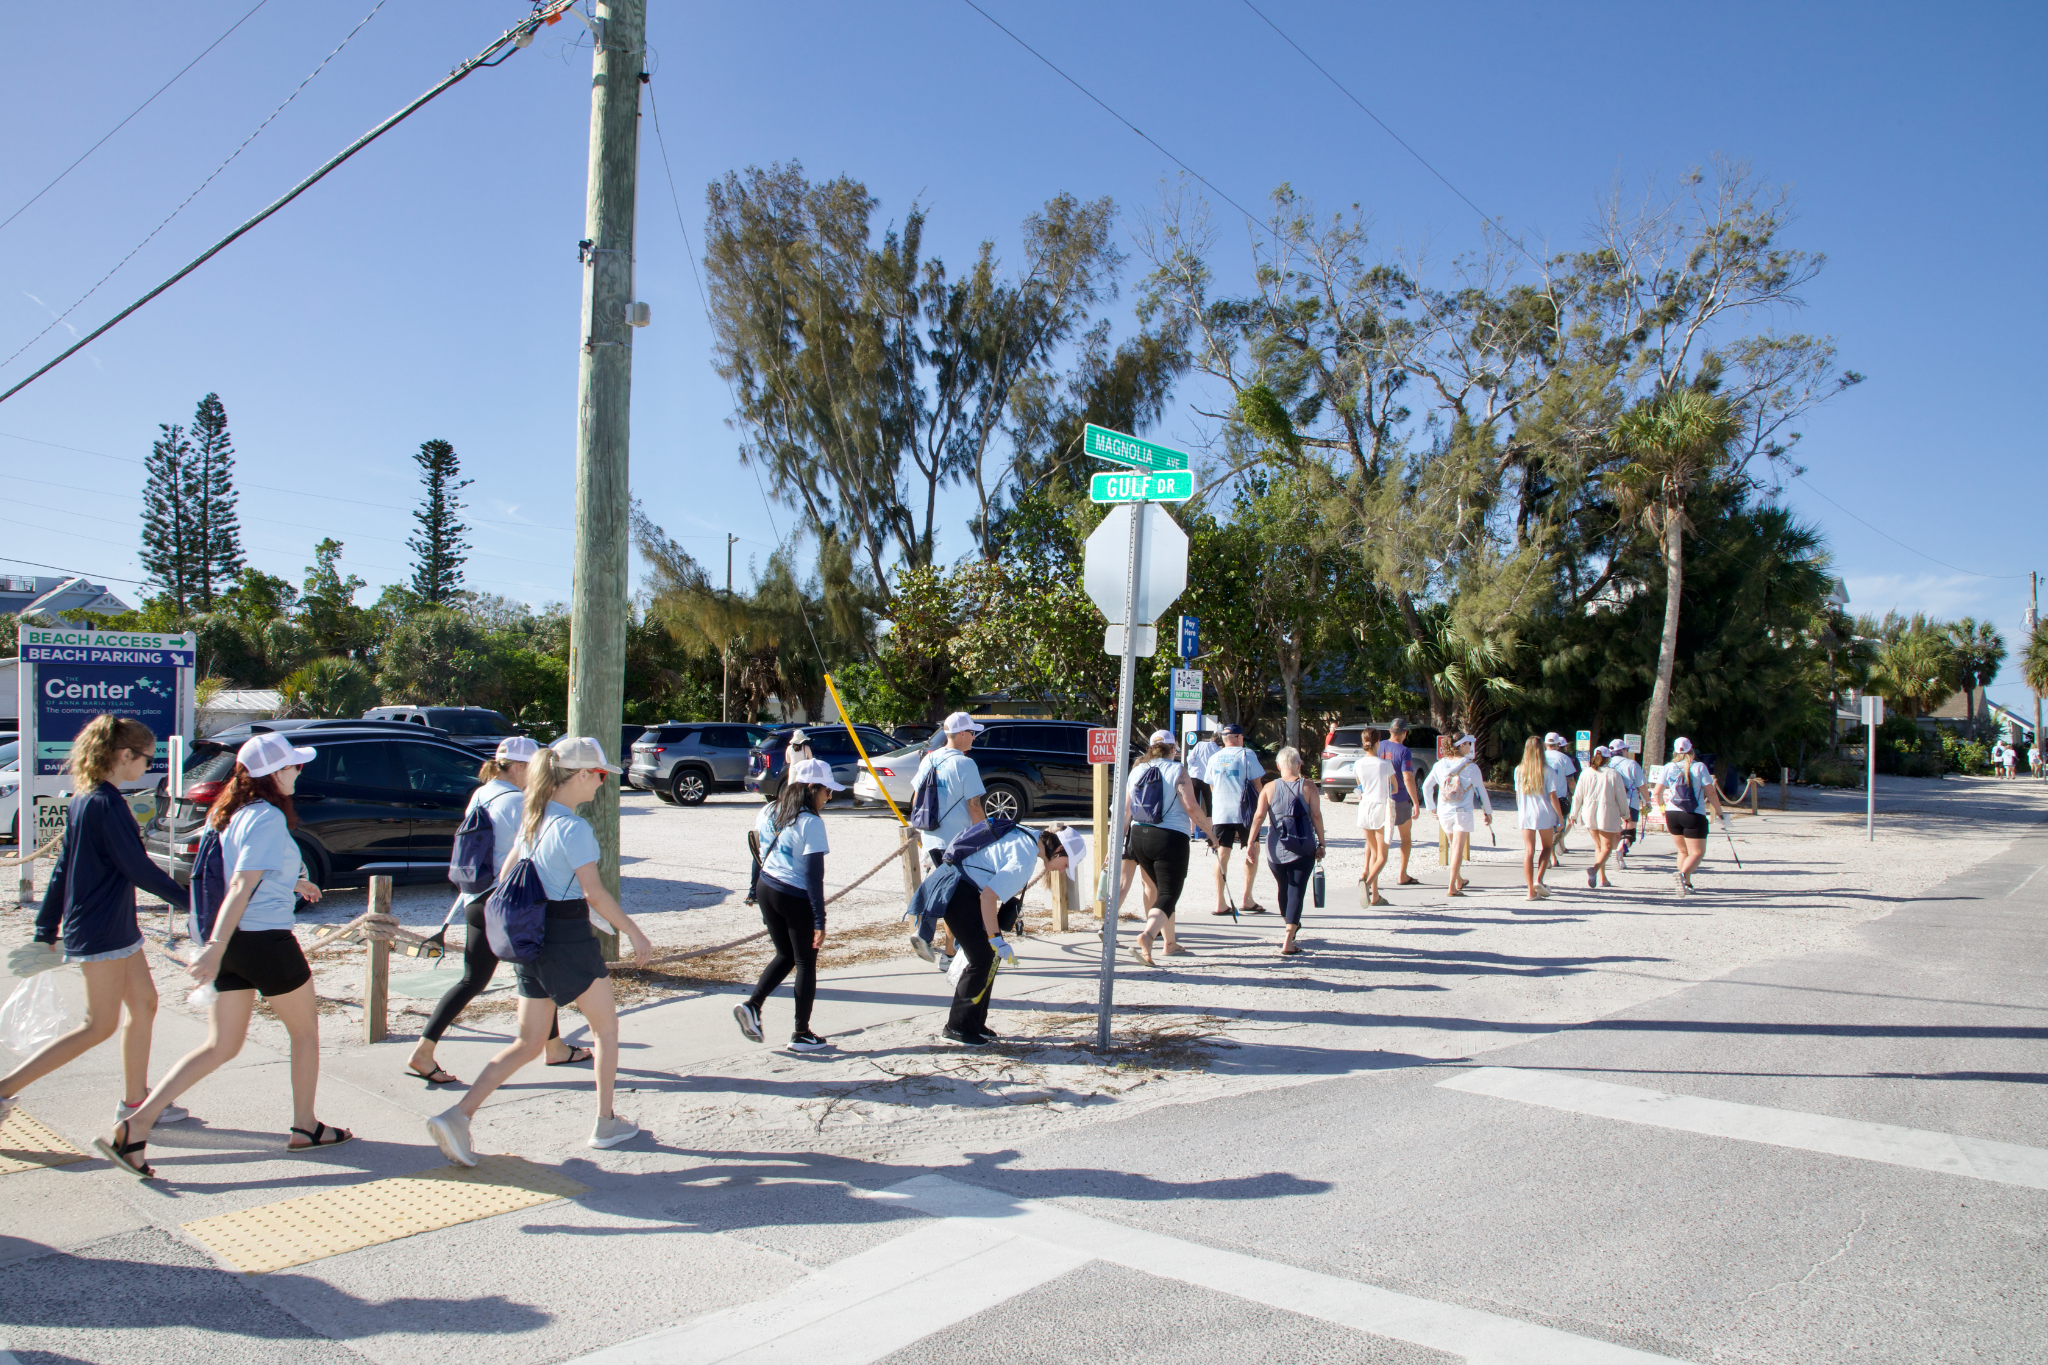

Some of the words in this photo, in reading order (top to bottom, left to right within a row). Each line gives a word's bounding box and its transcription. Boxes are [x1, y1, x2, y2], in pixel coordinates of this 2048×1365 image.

[1095, 433, 1153, 465] MAGNOLIA
[1166, 456, 1180, 469] AVE
[1107, 476, 1152, 498] GULF
[1157, 478, 1175, 494] DR
[1185, 619, 1196, 629] Pay
[1184, 628, 1197, 637] Here
[29, 632, 90, 646] BEACH
[94, 634, 163, 649] ACCESS
[28, 648, 87, 661] BEACH
[91, 650, 163, 664] PARKING
[45, 678, 135, 699] Center
[1189, 691, 1201, 699] PARK
[61, 707, 106, 715] community's
[108, 708, 141, 716] gathering
[143, 708, 162, 716] place
[1095, 732, 1116, 744] EXIT
